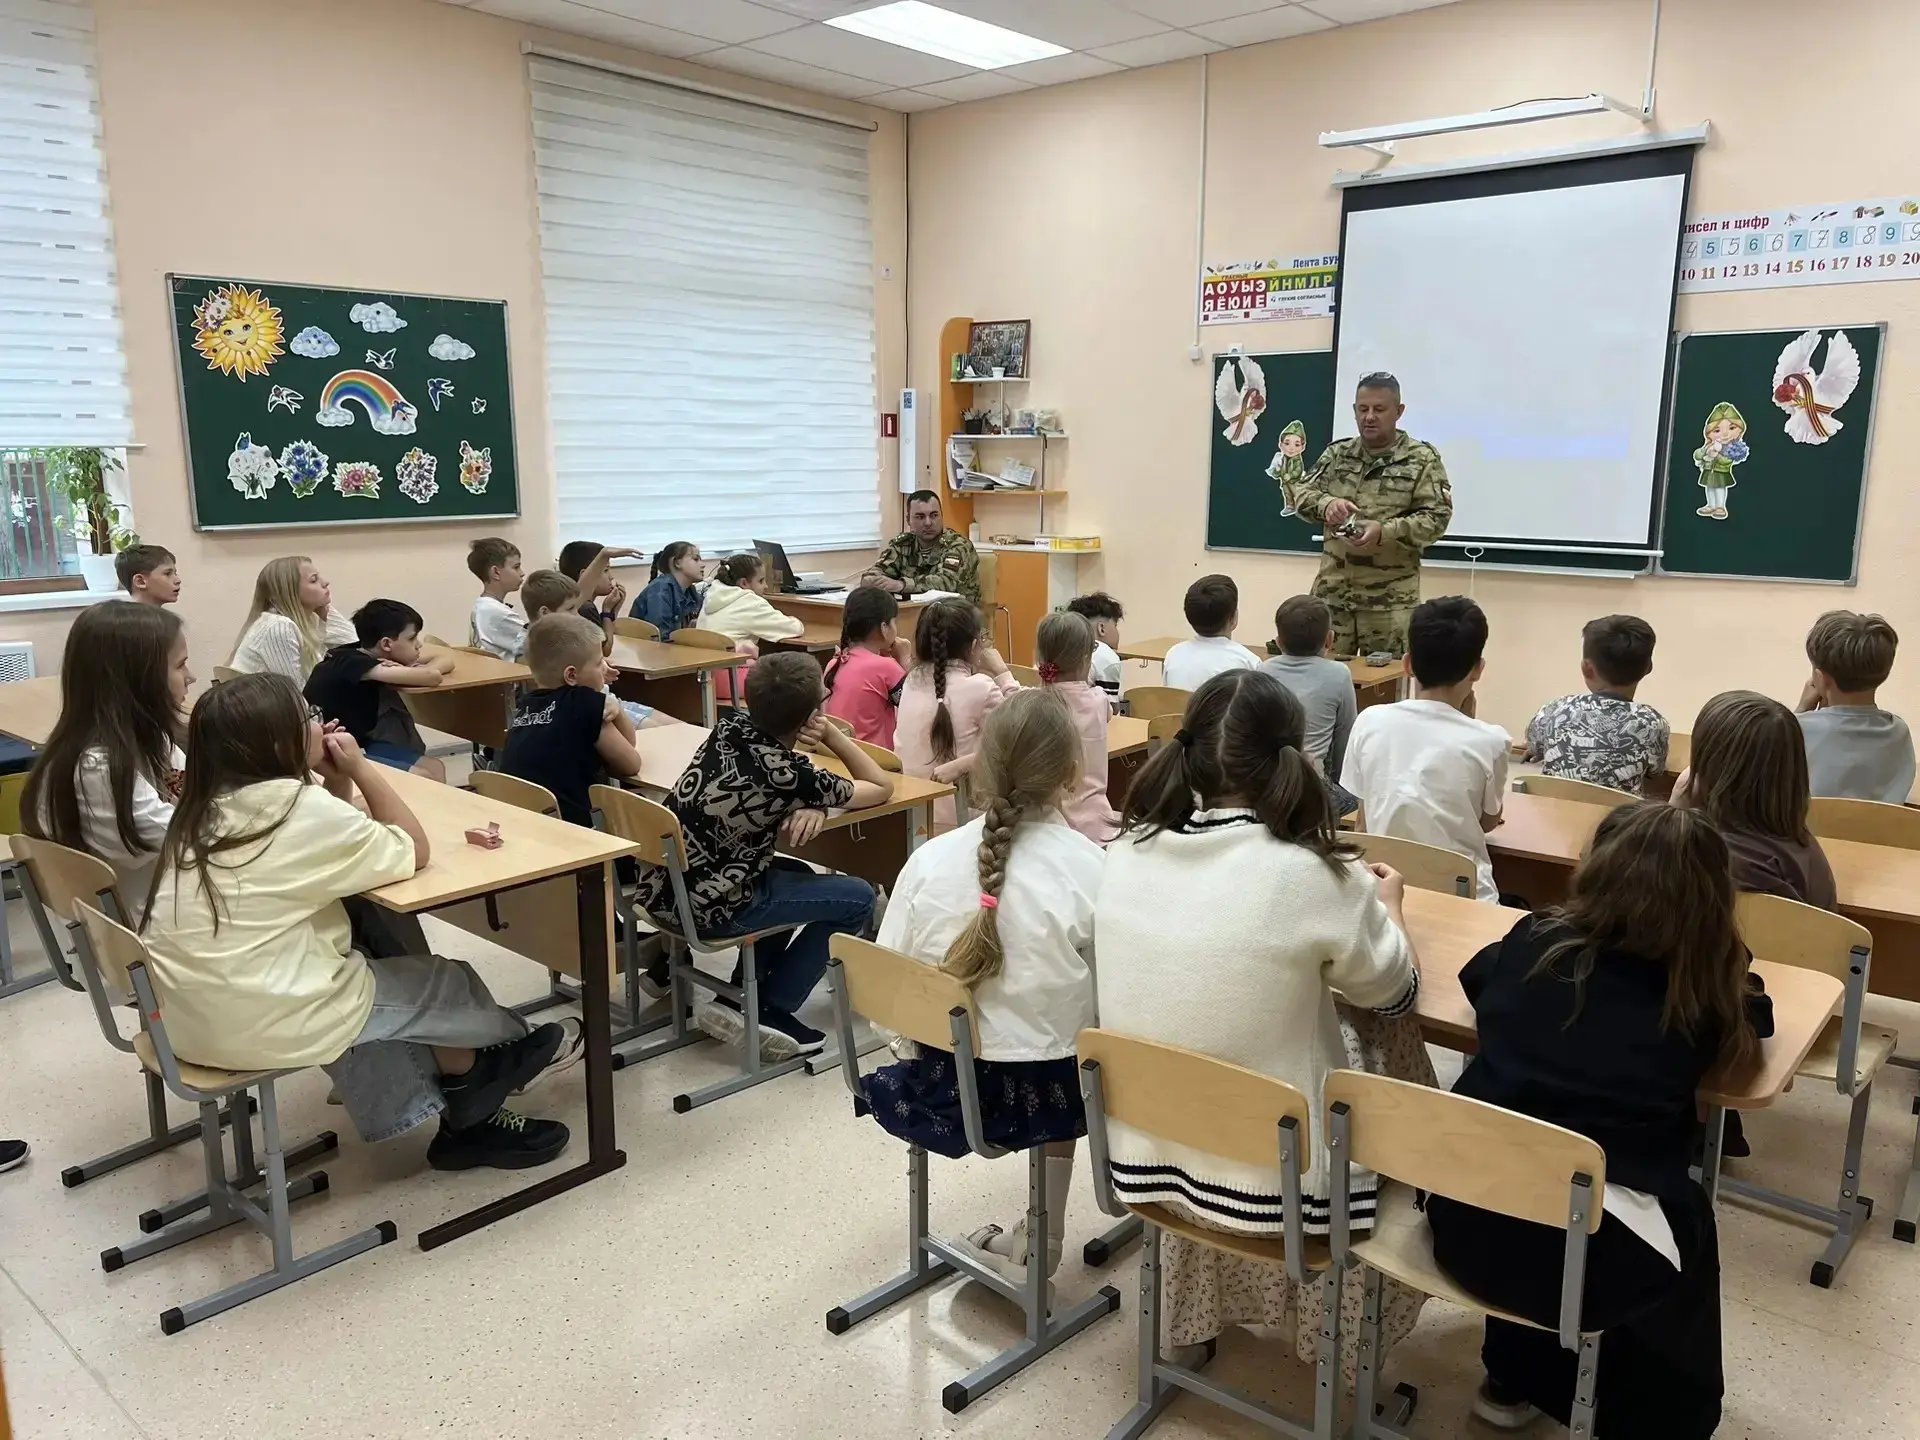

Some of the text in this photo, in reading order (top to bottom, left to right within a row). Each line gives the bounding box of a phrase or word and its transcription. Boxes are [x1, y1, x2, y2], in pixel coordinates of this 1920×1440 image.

[1721, 219, 1731, 230] и
[1734, 215, 1770, 230] цифр
[1705, 241, 1716, 254] 5
[1728, 237, 1740, 255] 5
[1749, 238, 1759, 251] 6
[1772, 233, 1784, 251] 6
[1793, 234, 1803, 247] 7
[1816, 229, 1829, 248] 7
[1838, 230, 1848, 243] 8
[1863, 225, 1876, 244] 8
[1885, 227, 1896, 240] 9
[1293, 258, 1320, 268] Лента
[1681, 252, 1920, 280] 10 11 12 13 14 15 16 17 18 19 20
